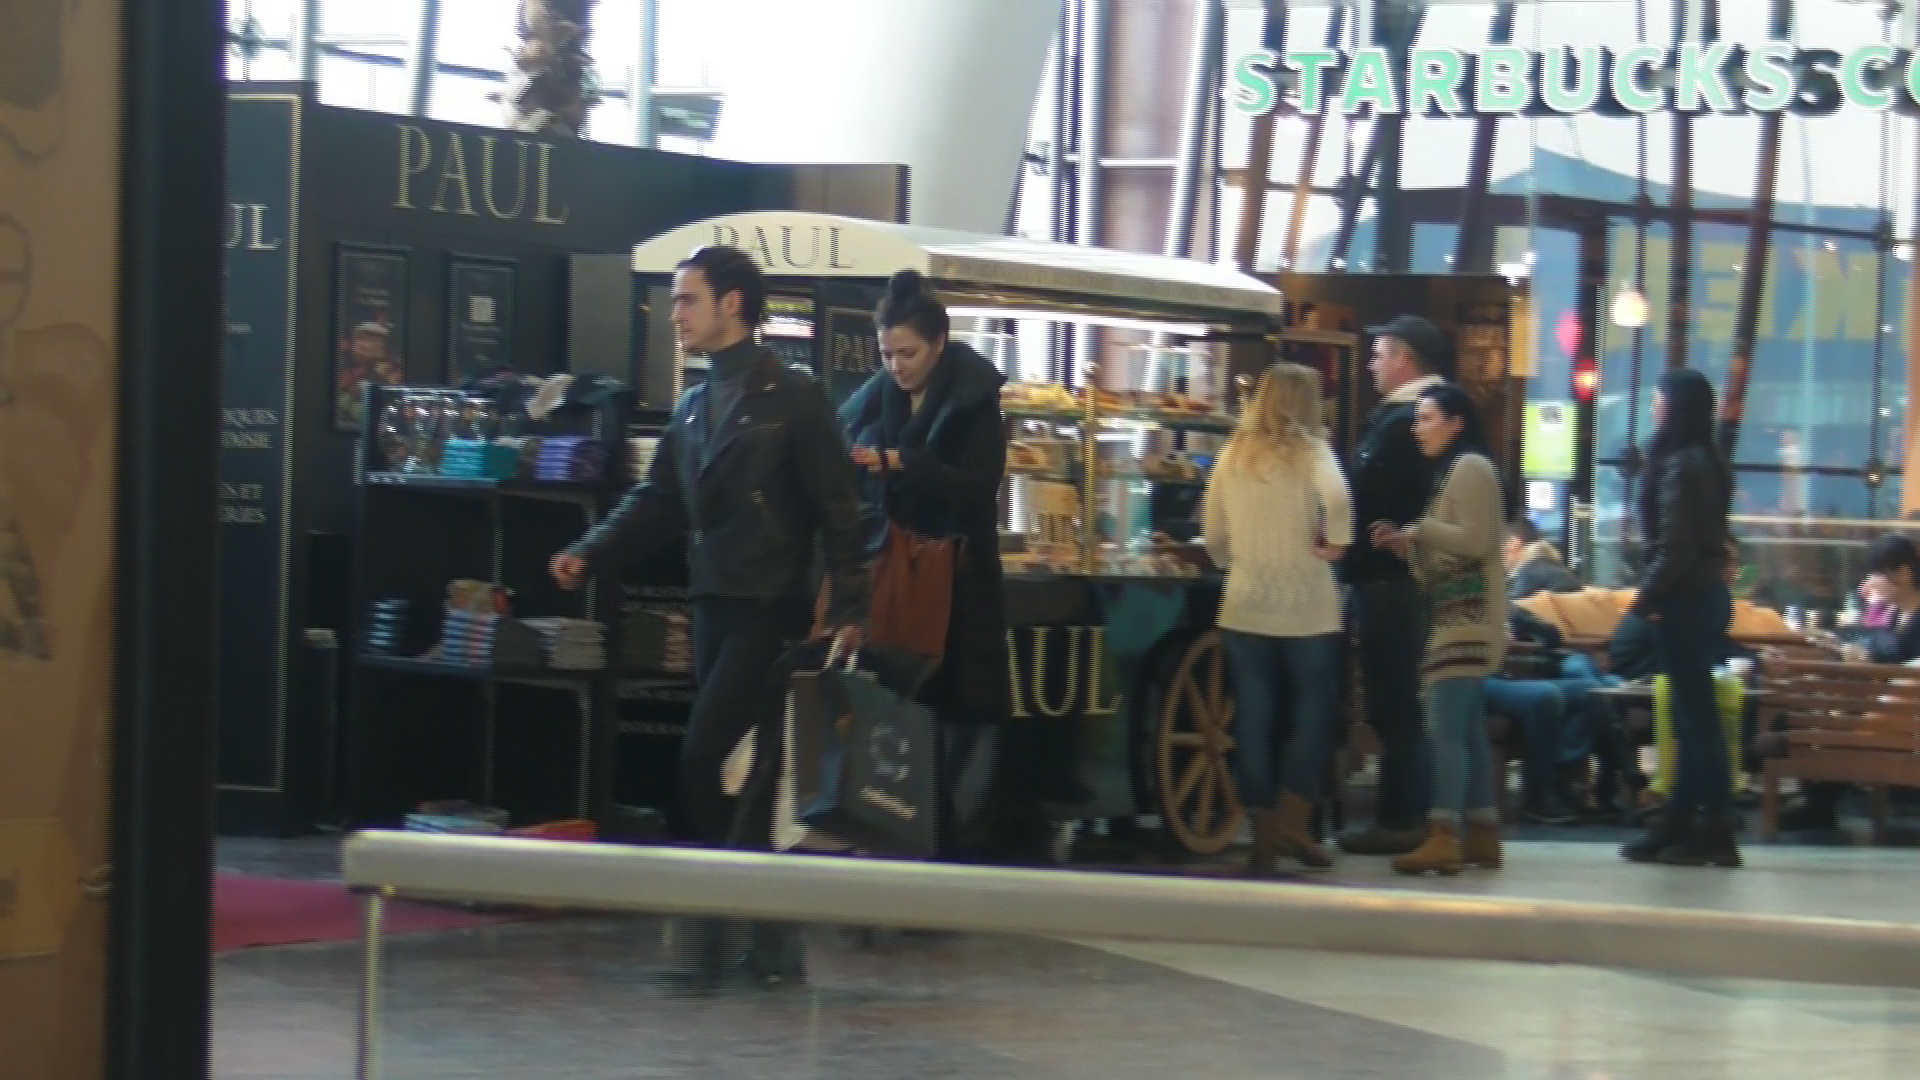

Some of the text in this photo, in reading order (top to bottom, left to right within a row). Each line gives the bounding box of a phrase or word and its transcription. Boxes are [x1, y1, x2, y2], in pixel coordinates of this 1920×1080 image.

[1233, 42, 1920, 116] STARBUCKS C
[391, 123, 571, 225] PAUL
